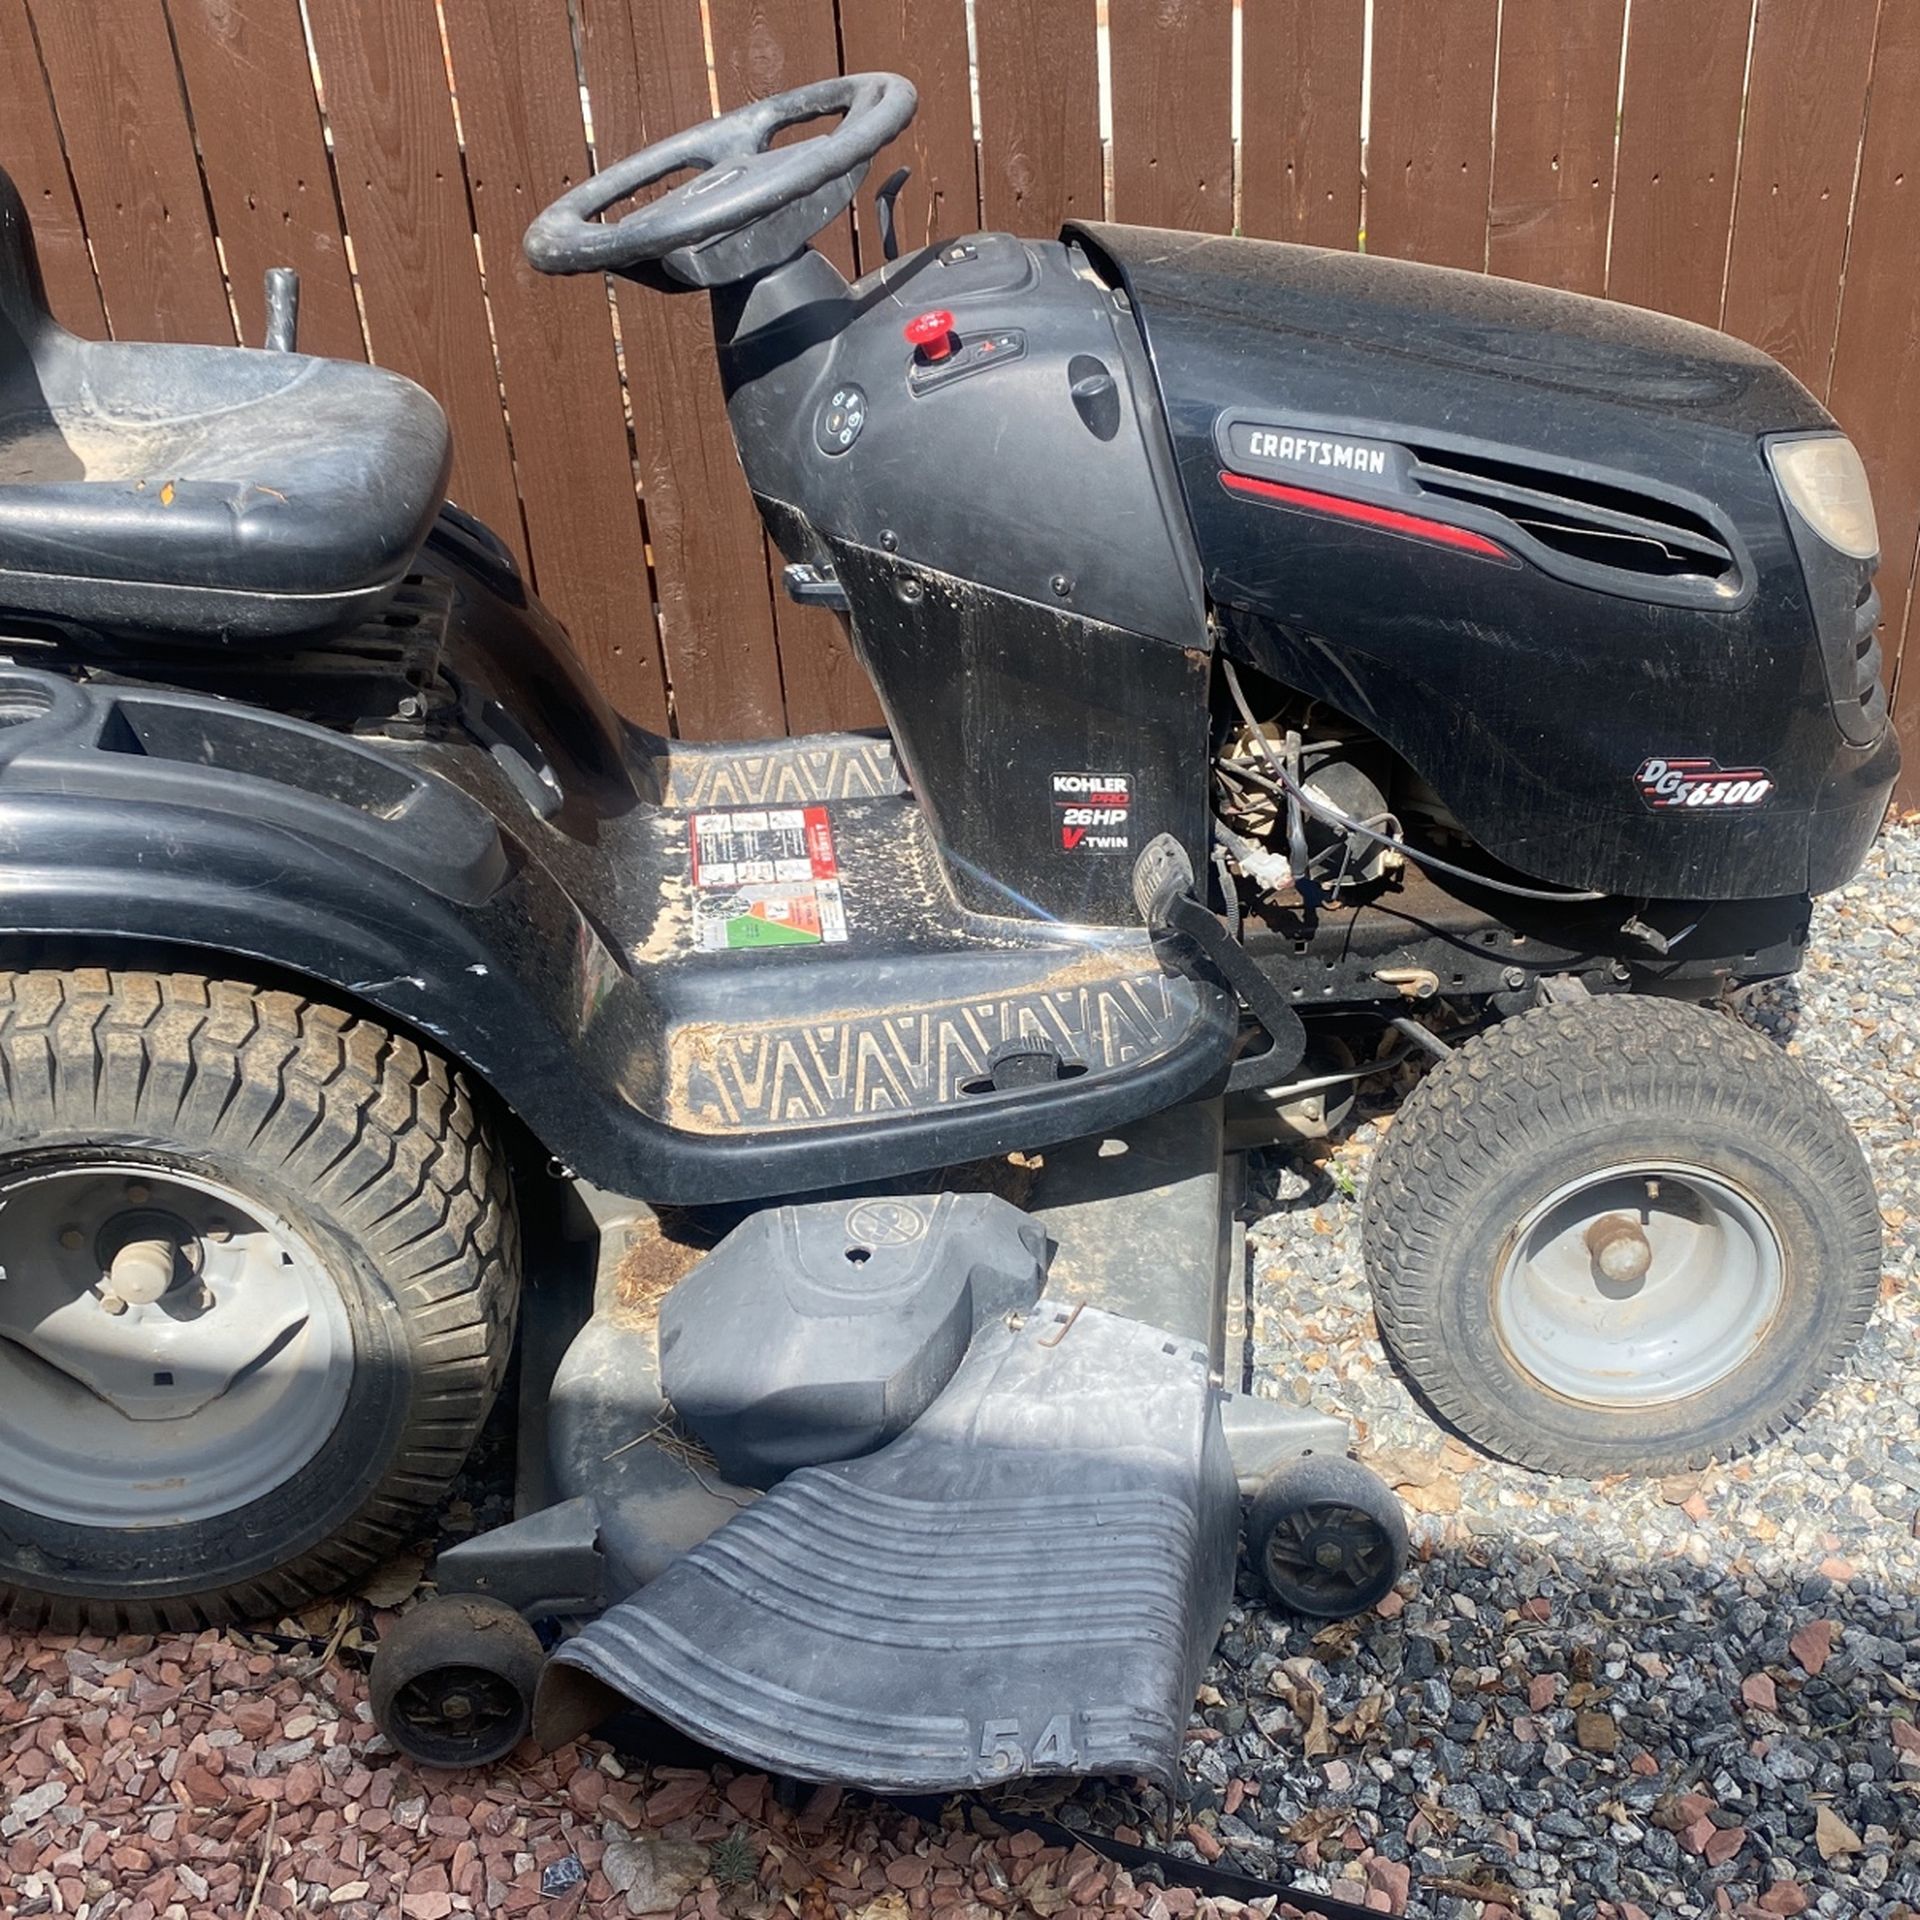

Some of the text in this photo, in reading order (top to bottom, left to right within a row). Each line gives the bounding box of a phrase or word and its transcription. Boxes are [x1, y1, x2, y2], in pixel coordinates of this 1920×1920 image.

[1250, 431, 1385, 474] CRAFTSMAN
[1053, 776, 1128, 792] KOHLER
[1091, 793, 1129, 803] PRO
[1063, 808, 1127, 825] 26HP
[1062, 827, 1128, 849] V-TWIN
[977, 1714, 1079, 1777] 54
